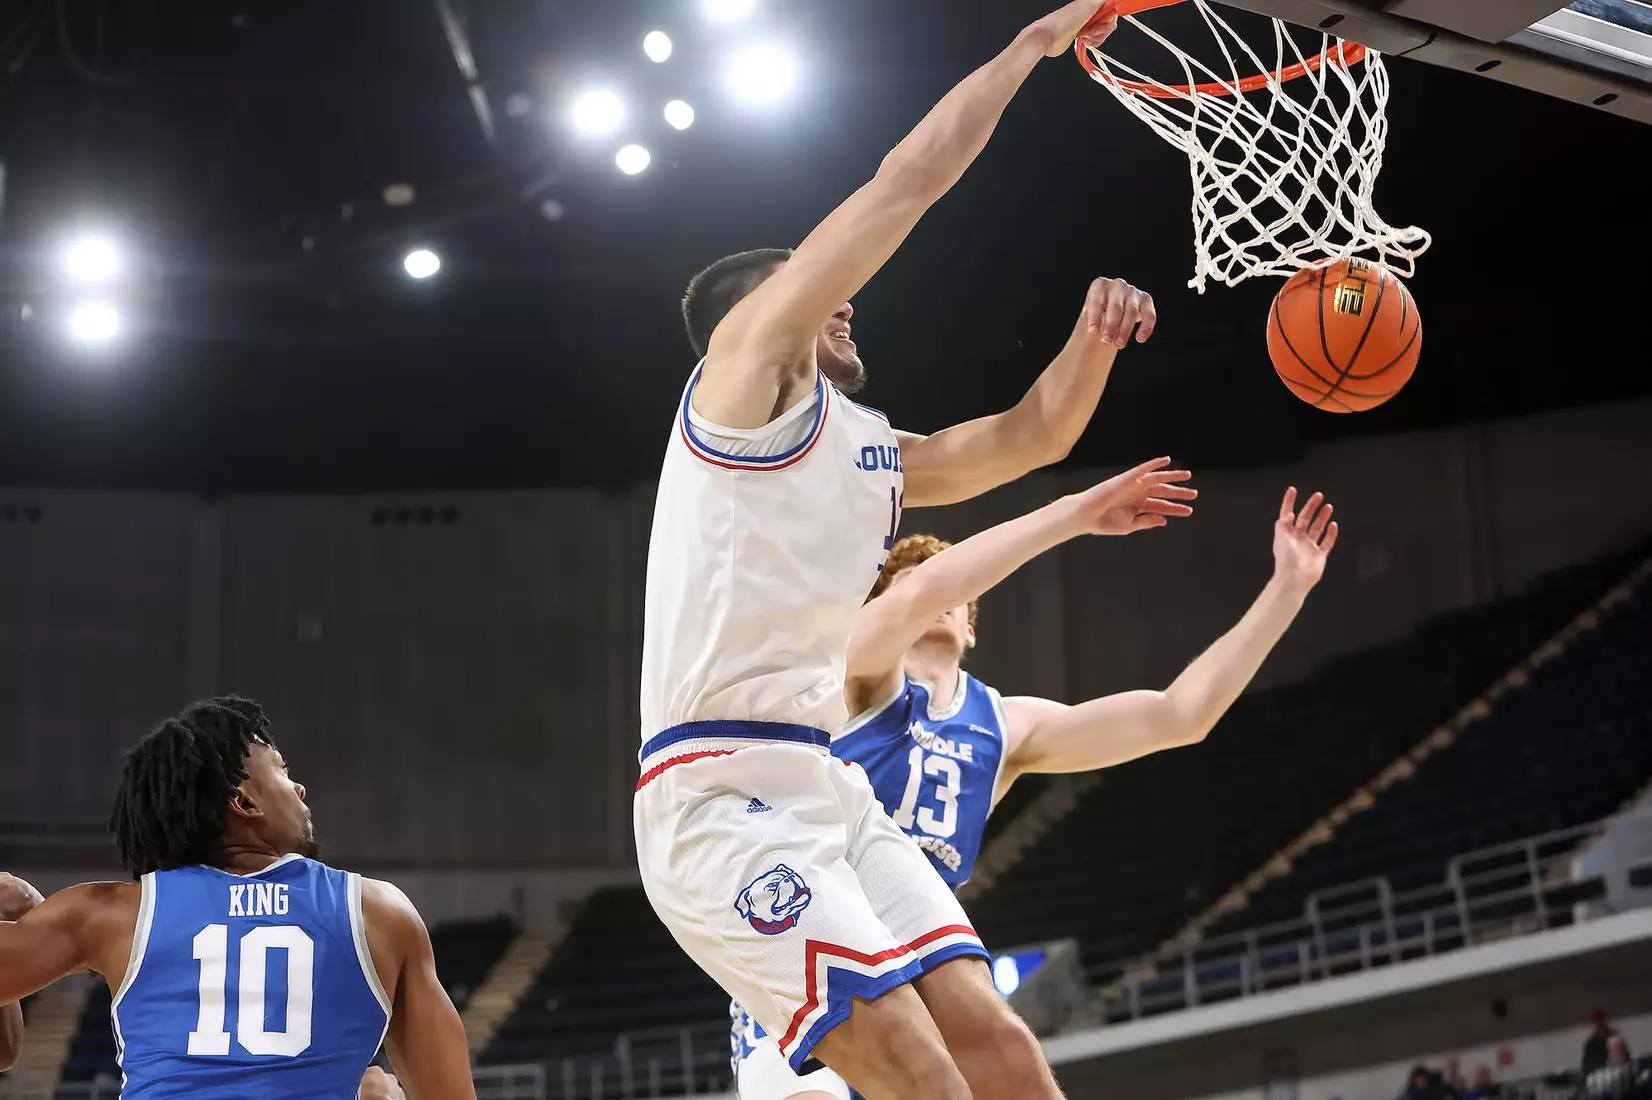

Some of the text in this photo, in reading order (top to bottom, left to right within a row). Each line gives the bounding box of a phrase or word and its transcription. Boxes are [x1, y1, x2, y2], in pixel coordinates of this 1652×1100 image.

[853, 445, 903, 473] OUI
[891, 746, 961, 838] 13
[228, 883, 289, 917] KING
[187, 923, 315, 1058] 10
